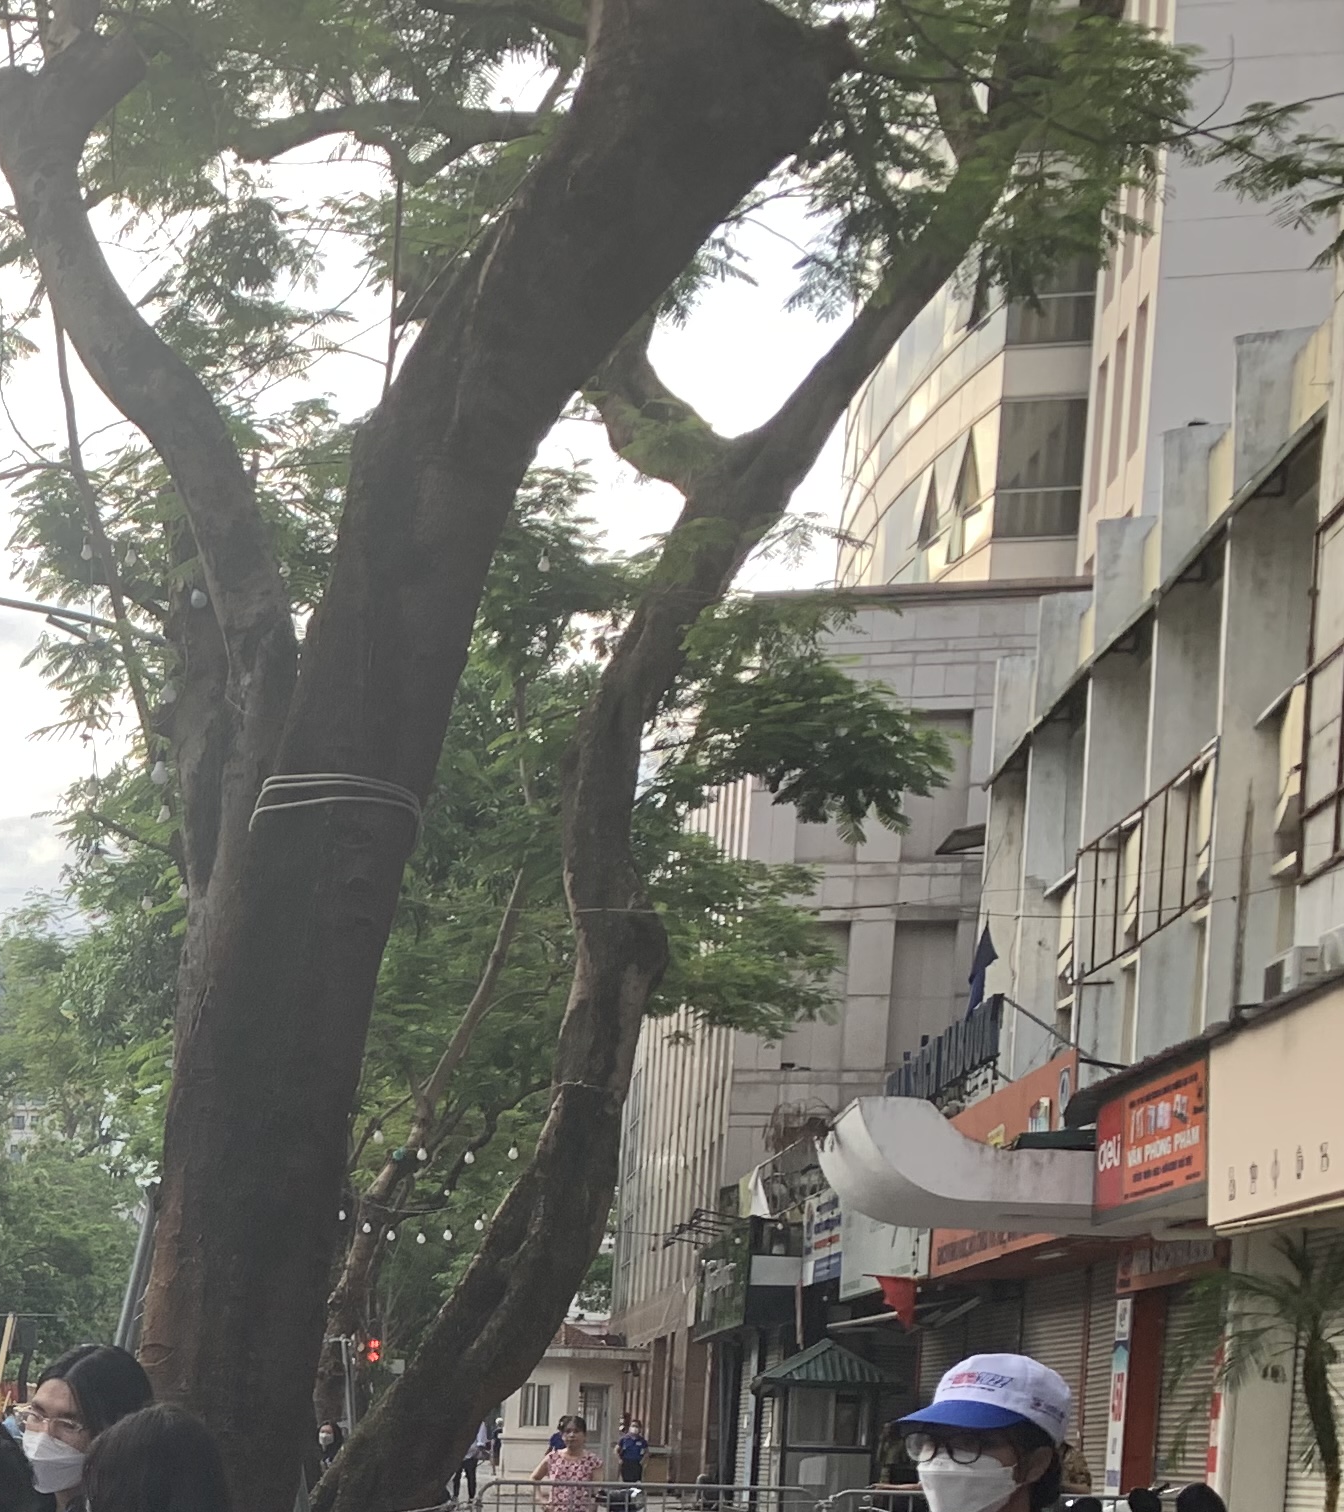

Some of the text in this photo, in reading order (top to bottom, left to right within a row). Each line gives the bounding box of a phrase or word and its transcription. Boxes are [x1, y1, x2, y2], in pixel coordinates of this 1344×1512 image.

[1097, 1133, 1121, 1173] deli
[1127, 1120, 1200, 1168] VĂN PHÒNG PHẨM
